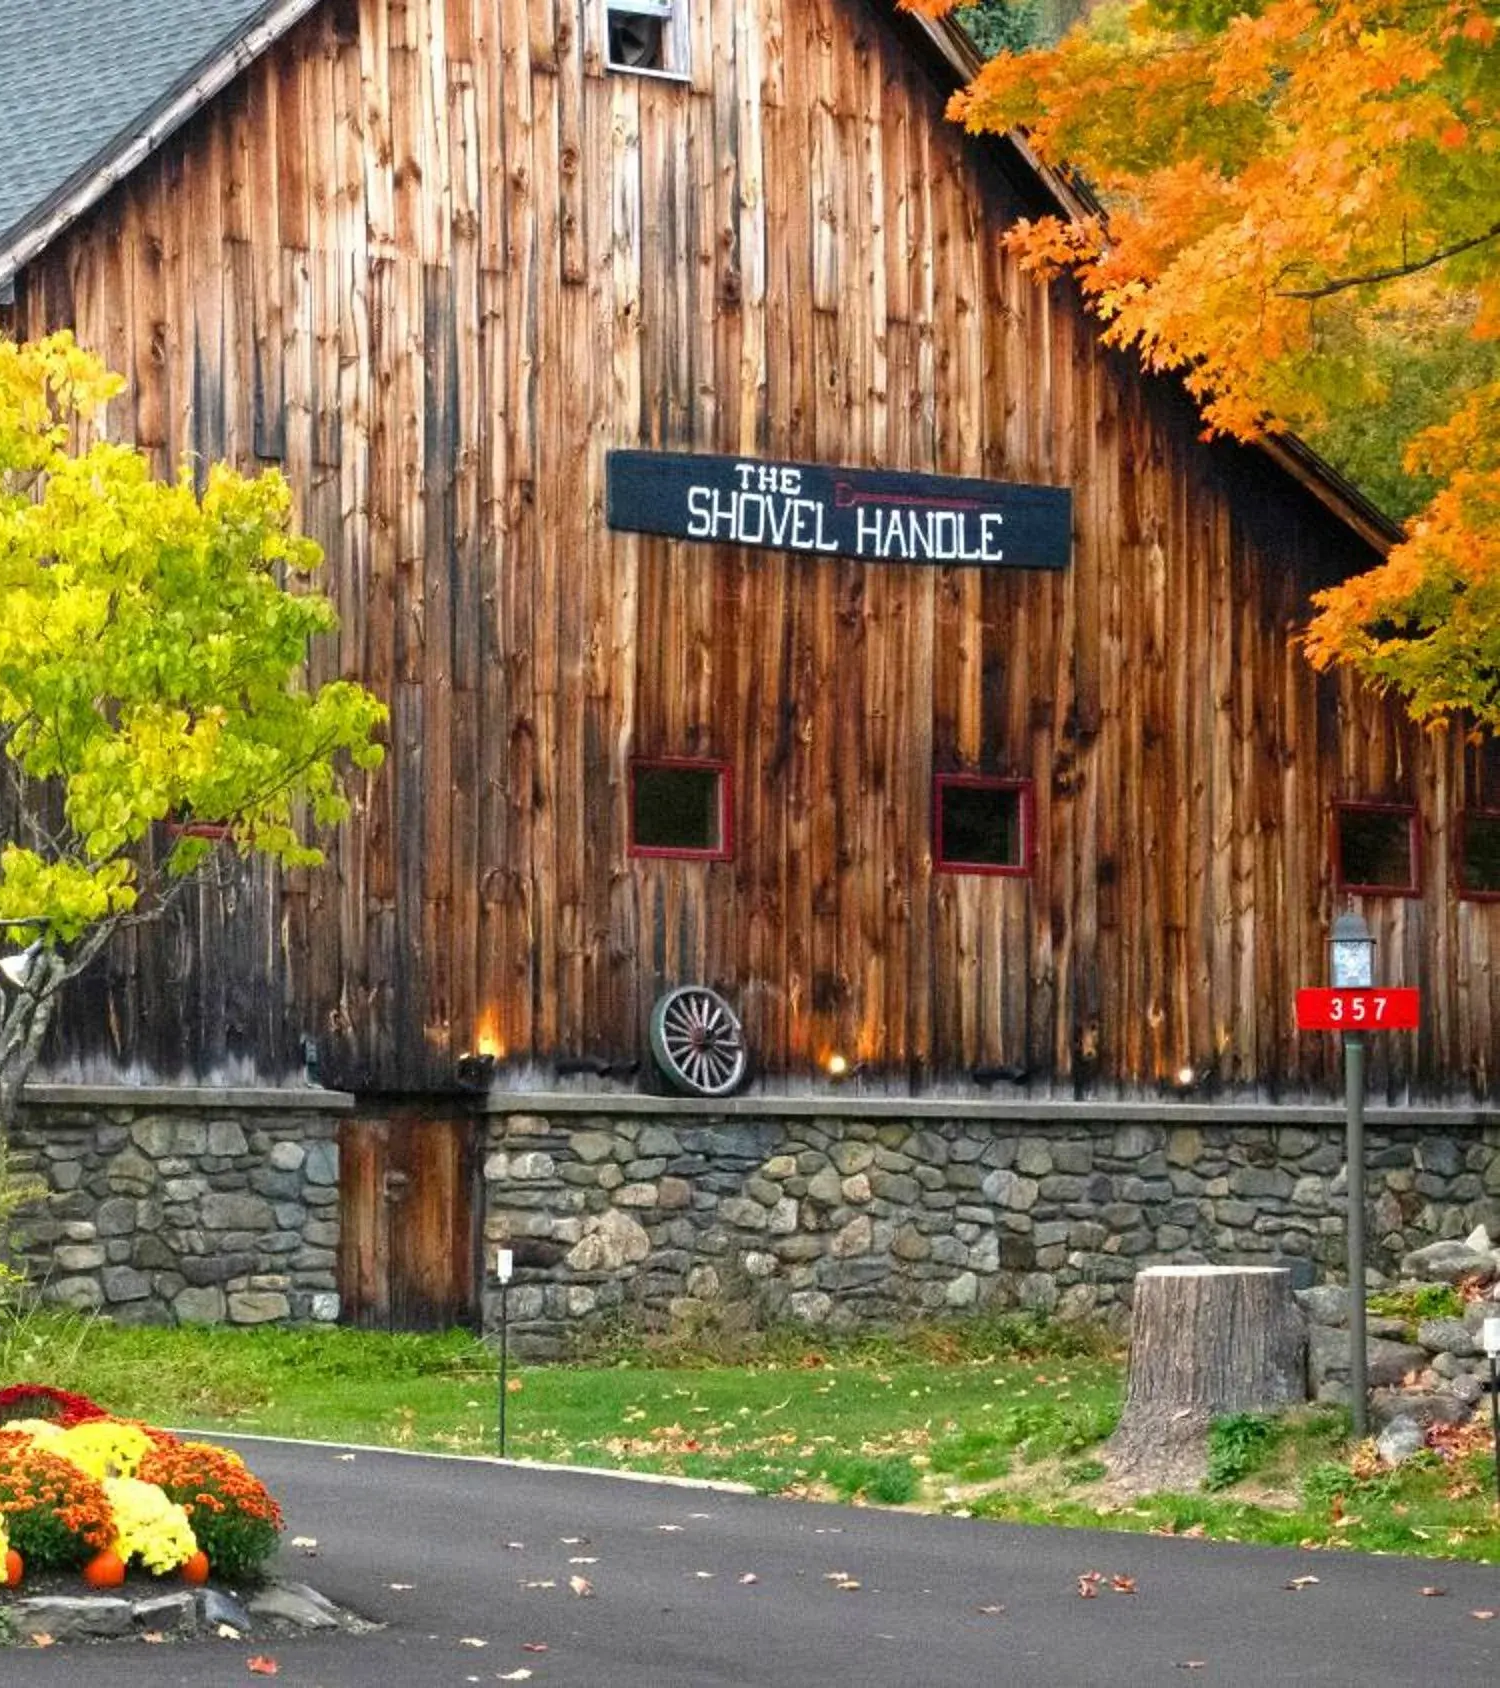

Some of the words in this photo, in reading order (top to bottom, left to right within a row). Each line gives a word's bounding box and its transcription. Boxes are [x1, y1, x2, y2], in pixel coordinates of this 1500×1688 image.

[735, 463, 801, 495] THE
[687, 487, 838, 551] SHOVEL
[856, 508, 1003, 561] HANDLE
[1329, 997, 1388, 1021] 357
